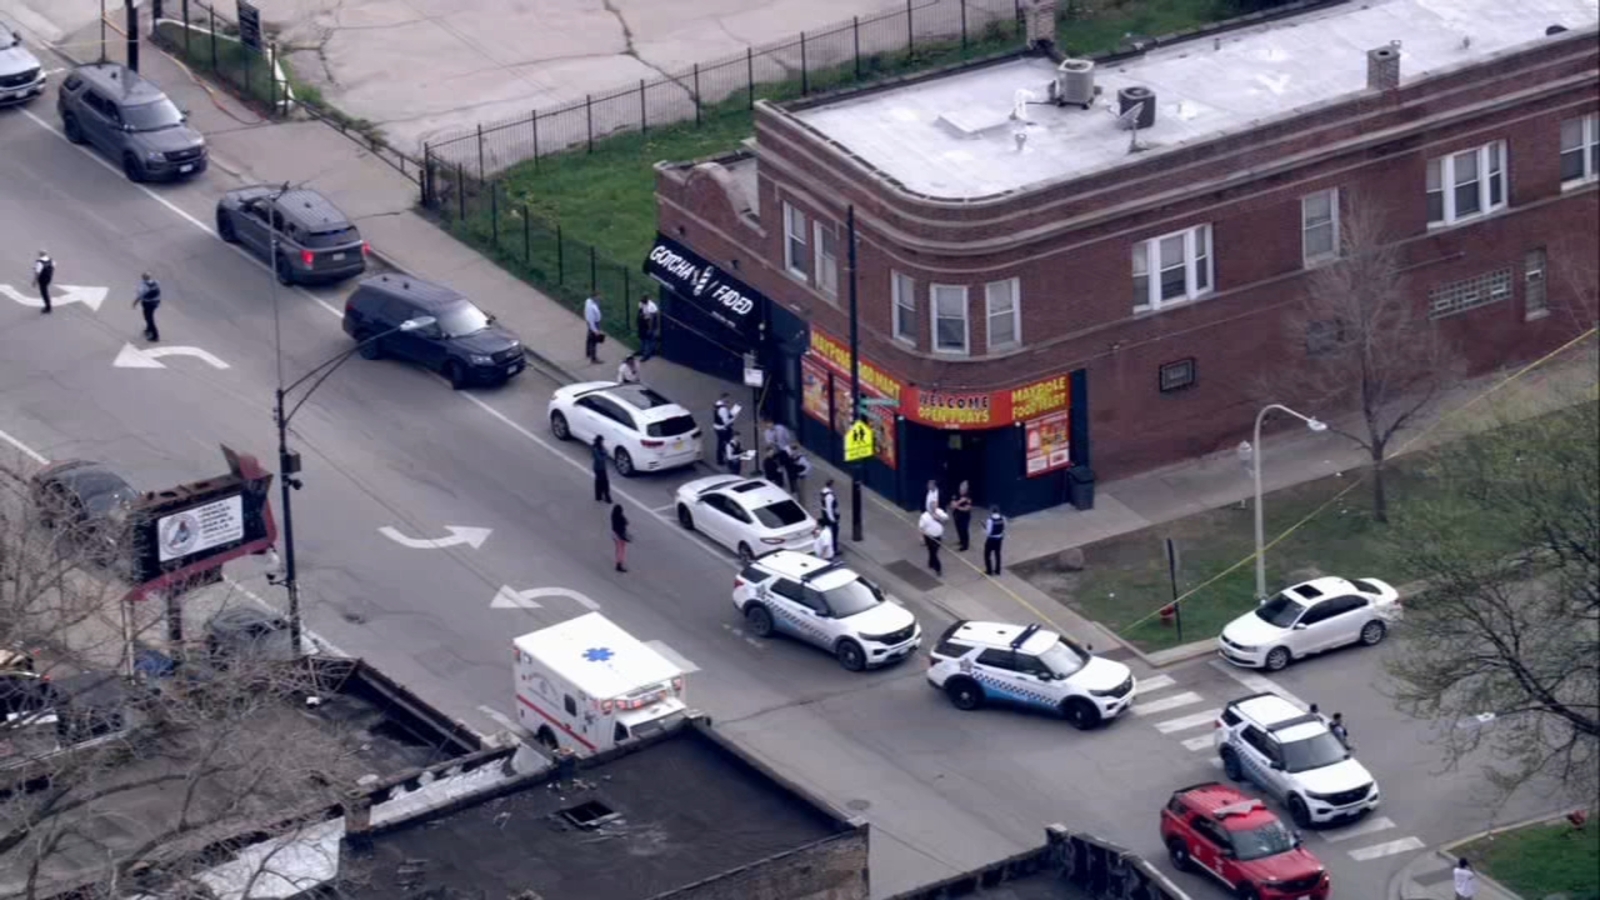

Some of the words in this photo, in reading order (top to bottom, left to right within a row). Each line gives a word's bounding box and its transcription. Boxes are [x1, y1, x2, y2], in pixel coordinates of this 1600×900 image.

[650, 245, 696, 280] GOTCHA
[711, 285, 754, 315] FADED
[919, 390, 987, 409] WELCOME
[1012, 376, 1066, 402] MAYPOLE
[918, 407, 946, 422] OPEN
[958, 409, 989, 423] DAYS
[1012, 401, 1038, 419] FOOD
[1039, 392, 1066, 410] MART
